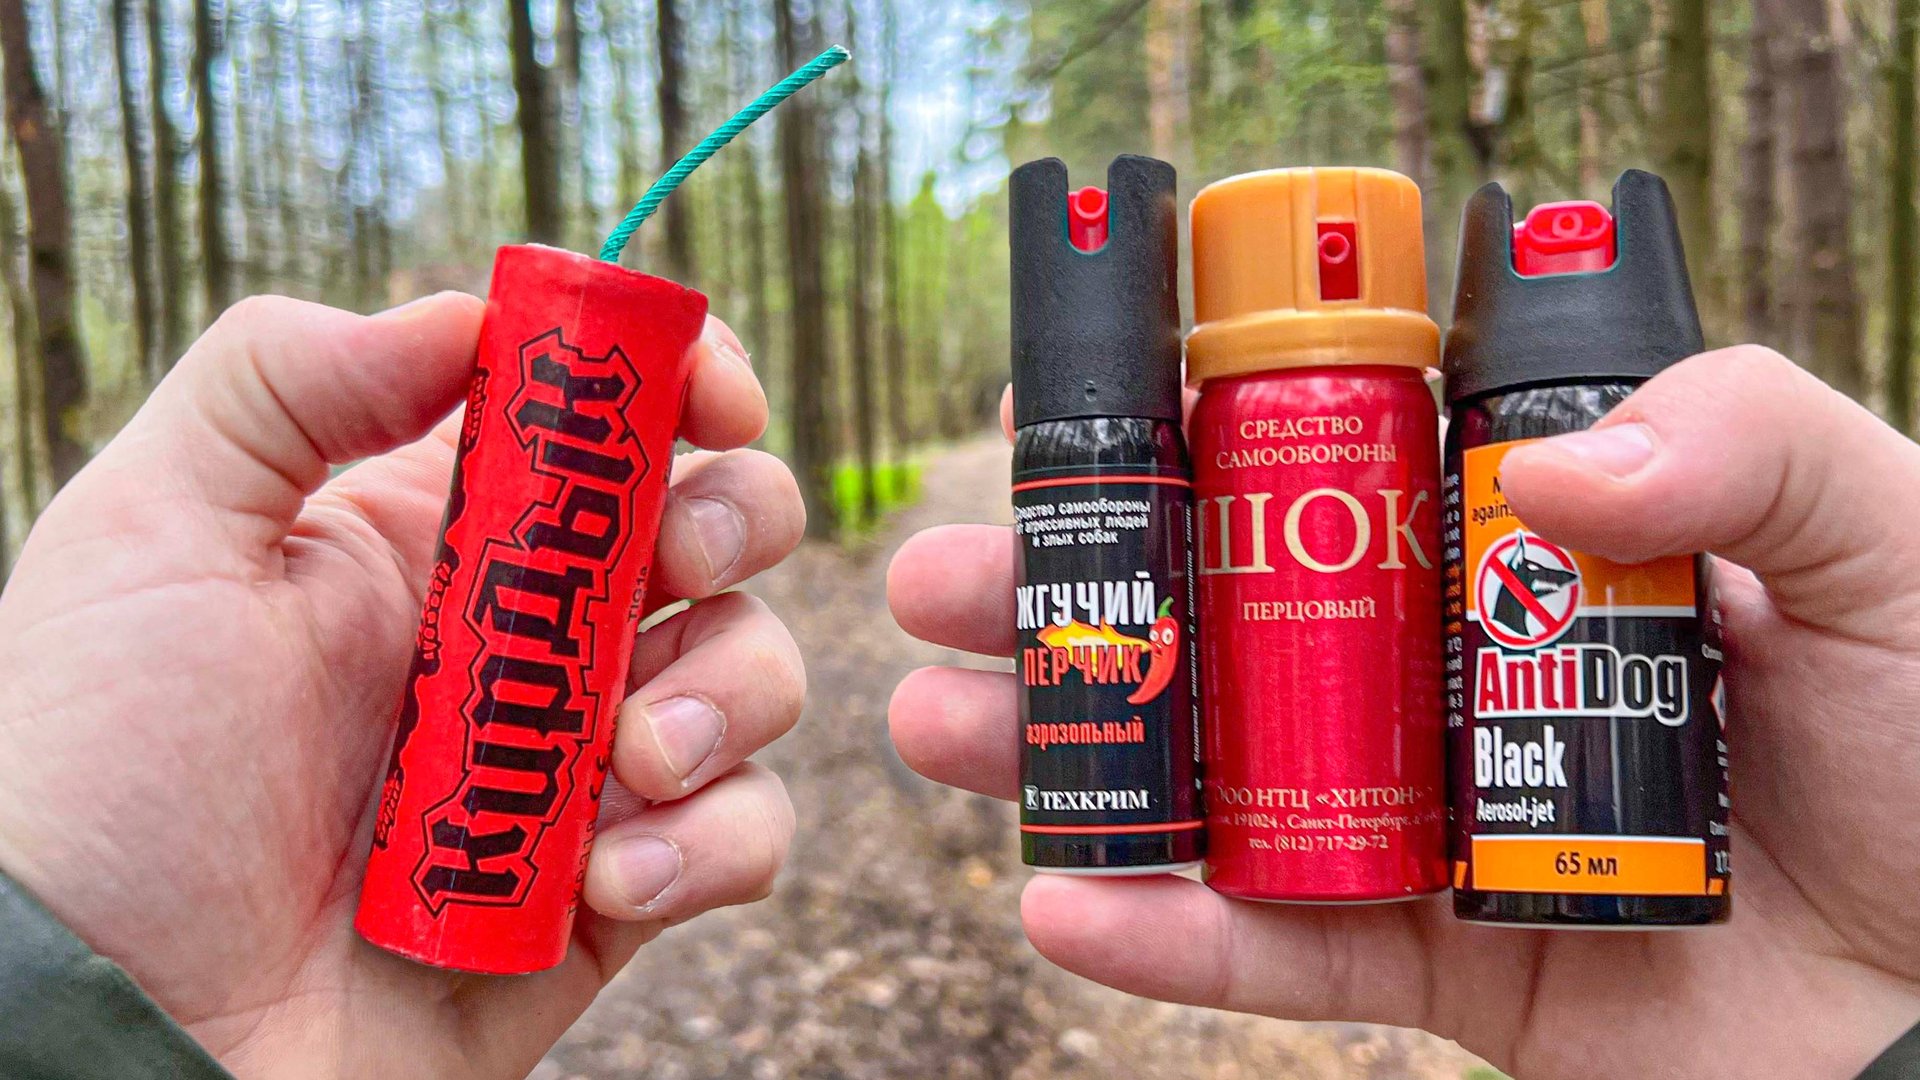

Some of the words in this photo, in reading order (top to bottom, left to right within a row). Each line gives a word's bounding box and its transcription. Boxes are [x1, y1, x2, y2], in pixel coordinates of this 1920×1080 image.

[1239, 416, 1364, 440] СРЕДСТВО
[1215, 444, 1398, 469] САМООБОРОНЫ
[1057, 497, 1151, 516] самообороны
[1472, 500, 1514, 526] again
[1024, 517, 1101, 536] агрессивных
[1104, 513, 1149, 531] людей
[1041, 533, 1075, 547] злых
[1077, 528, 1119, 545] собак
[1199, 487, 1434, 574] ШОК
[1016, 570, 1156, 630] ЖГУЧИЙ
[1242, 596, 1376, 623] ПЕРЦОВЫЙ
[1023, 645, 1143, 687] ПЕРЧИК
[1026, 716, 1145, 751] аэрозольный
[1473, 724, 1568, 788] Black
[1040, 789, 1150, 810] ТЕХКРИМ
[1256, 787, 1310, 811] НТЦ
[1476, 797, 1556, 828] Aerosol-jet
[1274, 833, 1314, 854] (812)
[1315, 833, 1389, 851] 717-29-72
[1555, 851, 1581, 876] 65
[1587, 857, 1618, 877] мл
